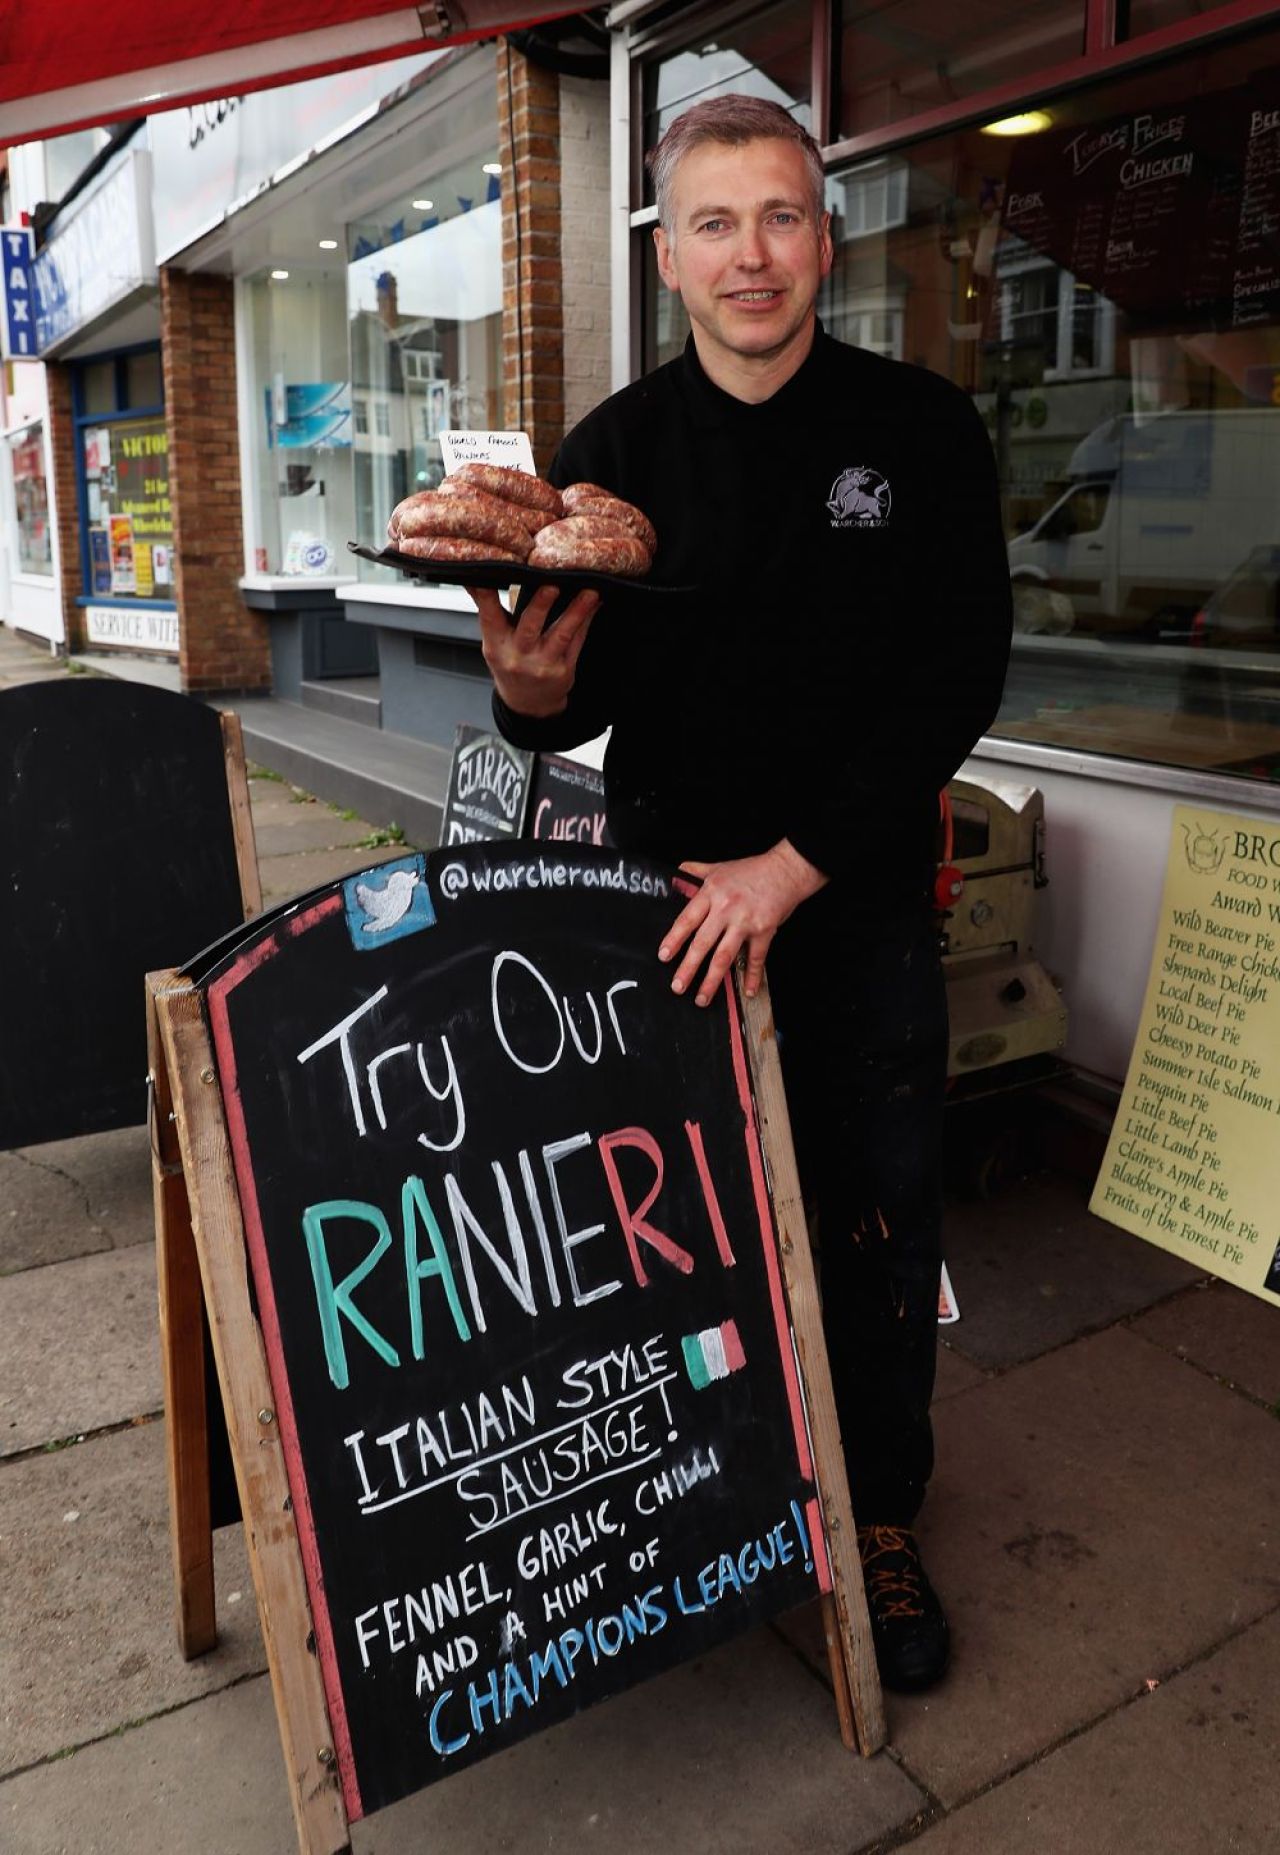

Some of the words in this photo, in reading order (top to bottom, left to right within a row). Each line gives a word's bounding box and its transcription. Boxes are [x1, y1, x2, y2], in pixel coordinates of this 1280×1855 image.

[1131, 114, 1187, 155] PRICES
[1119, 151, 1194, 184] CHICKEN
[7, 233, 29, 353] TAXI
[94, 613, 143, 639] SERVICE
[534, 797, 607, 846] CHECK
[440, 856, 668, 900] @warcherandson
[1227, 868, 1268, 889] FOOD
[1211, 890, 1262, 918] Award
[1167, 933, 1194, 954] Free
[1197, 942, 1238, 970] Range
[1173, 909, 1202, 932] Wild
[1205, 919, 1251, 944] Beaver
[1254, 933, 1275, 951] Pie
[1159, 980, 1195, 1004] Local
[1196, 992, 1226, 1019] Beef
[1226, 1003, 1247, 1022] Pie
[1220, 973, 1268, 1004] Delight
[1155, 1003, 1185, 1026] Wild
[1187, 1014, 1219, 1037] Deer
[1221, 1026, 1241, 1046] Pie
[297, 984, 466, 1152] Try
[491, 950, 638, 1074] Our
[1149, 1023, 1193, 1058] Cheesy
[1195, 1043, 1238, 1070] Potato
[1241, 1059, 1262, 1080] Pie
[1137, 1073, 1188, 1105] Penguin
[1190, 1093, 1210, 1114] Pie
[1142, 1050, 1197, 1080] Summer
[1197, 1068, 1221, 1091] Isle
[1222, 1078, 1274, 1112] Salmon
[1131, 1095, 1166, 1121] Little
[1168, 1110, 1199, 1138] Beef
[1198, 1123, 1218, 1143] Pie
[1117, 1139, 1165, 1174] Claire's
[1166, 1165, 1206, 1192] Apple
[1208, 1181, 1229, 1202] Pie
[1124, 1118, 1160, 1144] Little
[1161, 1133, 1199, 1161] Lamb
[1201, 1151, 1222, 1172] Pie
[1103, 1186, 1140, 1215] Fruits
[1141, 1202, 1157, 1227] of
[1157, 1208, 1178, 1234] the
[1180, 1223, 1220, 1254] Forest
[1222, 1243, 1245, 1265] Pie
[1111, 1161, 1178, 1210] Blackberry
[1179, 1196, 1192, 1213] &
[1194, 1204, 1235, 1234] Apple
[1238, 1223, 1260, 1245] Pie
[302, 1119, 736, 1390] RANIERI
[344, 1375, 536, 1505] ITALIAN
[556, 1333, 669, 1408] STYLE
[457, 1383, 679, 1528] SAUSAGE!
[355, 1561, 512, 1668] FENNEL,
[516, 1500, 627, 1580] GARLIC,
[415, 1635, 479, 1696] AND
[505, 1611, 527, 1645] A
[542, 1563, 607, 1623] HINT
[629, 1538, 661, 1573] OF
[429, 1585, 668, 1756] CHAMPIONS
[672, 1500, 814, 1616] LEAGUE!
